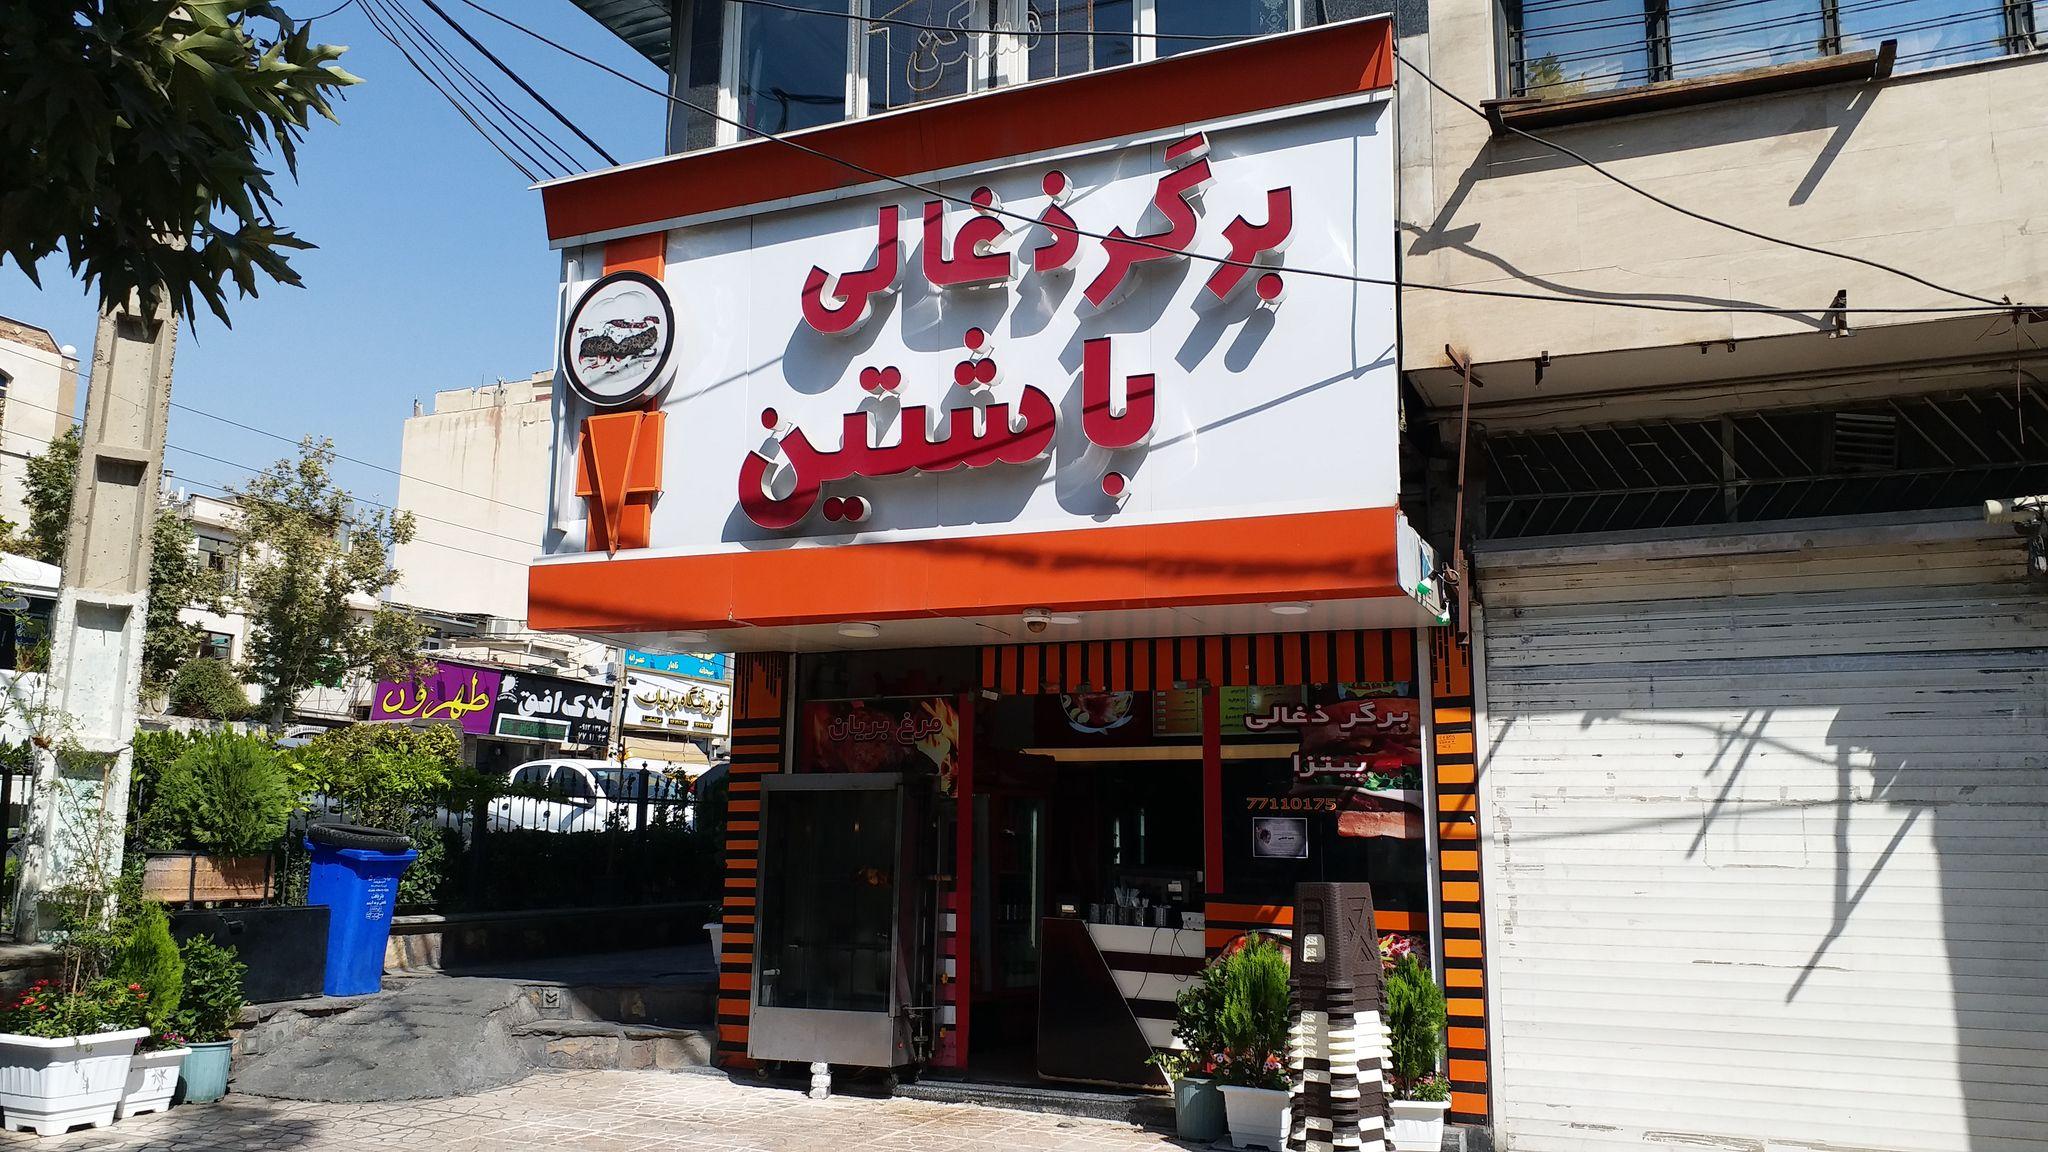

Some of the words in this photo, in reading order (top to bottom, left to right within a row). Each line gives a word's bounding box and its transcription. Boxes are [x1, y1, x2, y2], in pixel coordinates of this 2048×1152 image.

[828, 714, 890, 741] بریان
[896, 711, 943, 745] مرغ
[1245, 704, 1330, 729] ذغالی
[1340, 701, 1410, 729] برگر
[1293, 754, 1368, 782] پیتزا
[1246, 796, 1338, 811] 77110175
